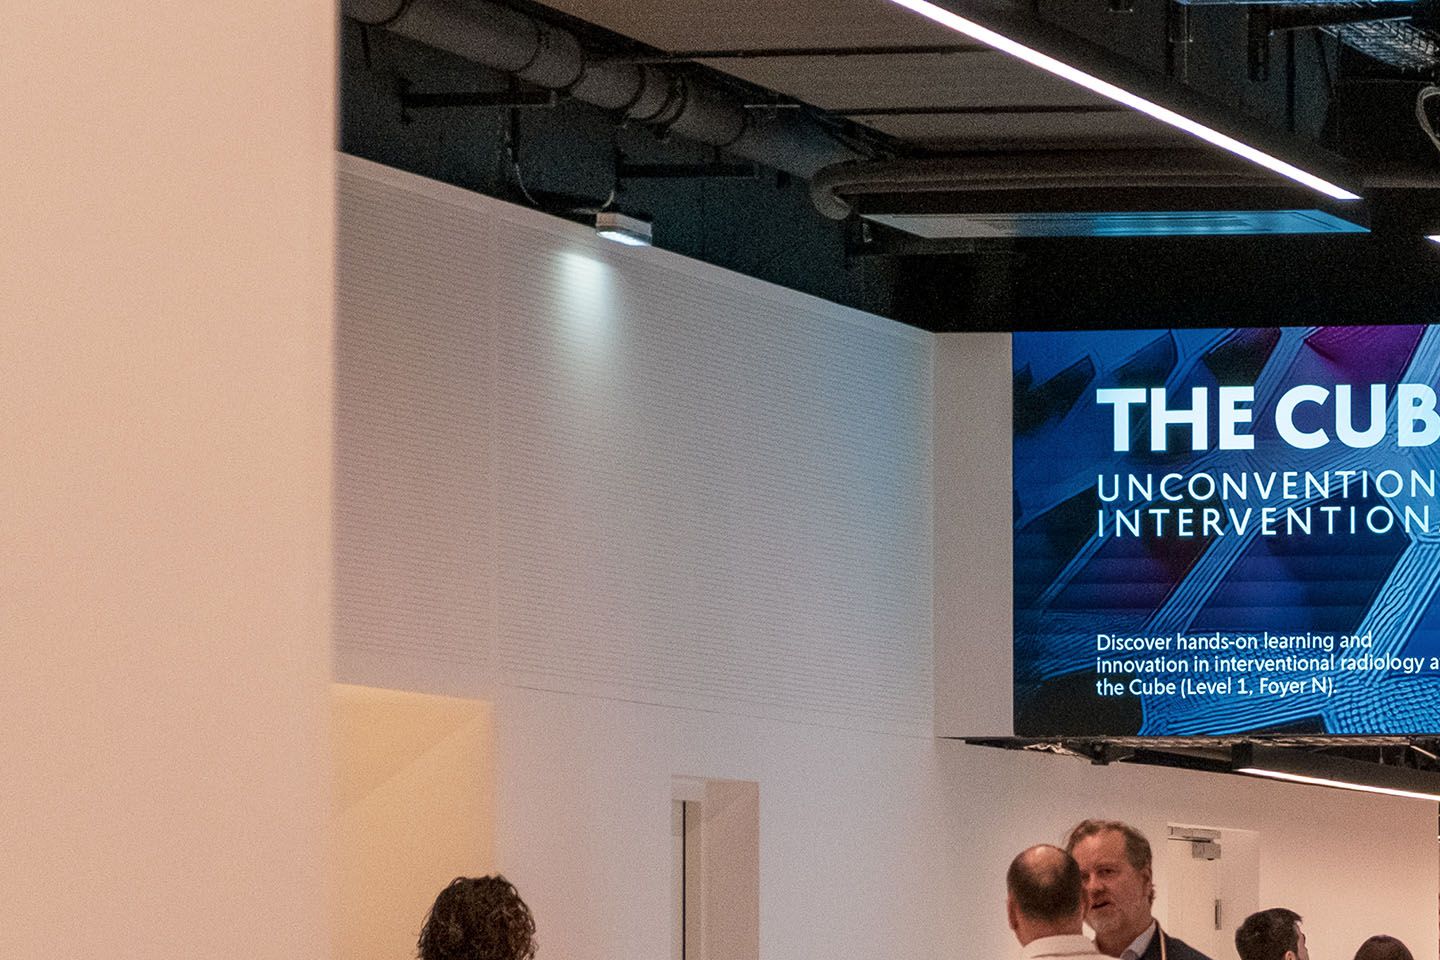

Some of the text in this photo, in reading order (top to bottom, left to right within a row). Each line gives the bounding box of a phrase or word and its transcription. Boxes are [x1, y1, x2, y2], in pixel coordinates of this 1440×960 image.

[1096, 384, 1255, 452] THE
[1096, 630, 1372, 652] Discover hands-on learning and
[1096, 656, 1189, 673] innovation
[1194, 655, 1209, 673] in
[1215, 654, 1334, 673] interventional
[1341, 652, 1425, 674] radiology
[1096, 676, 1337, 698] the Cube (Level 1, Foyer N).
